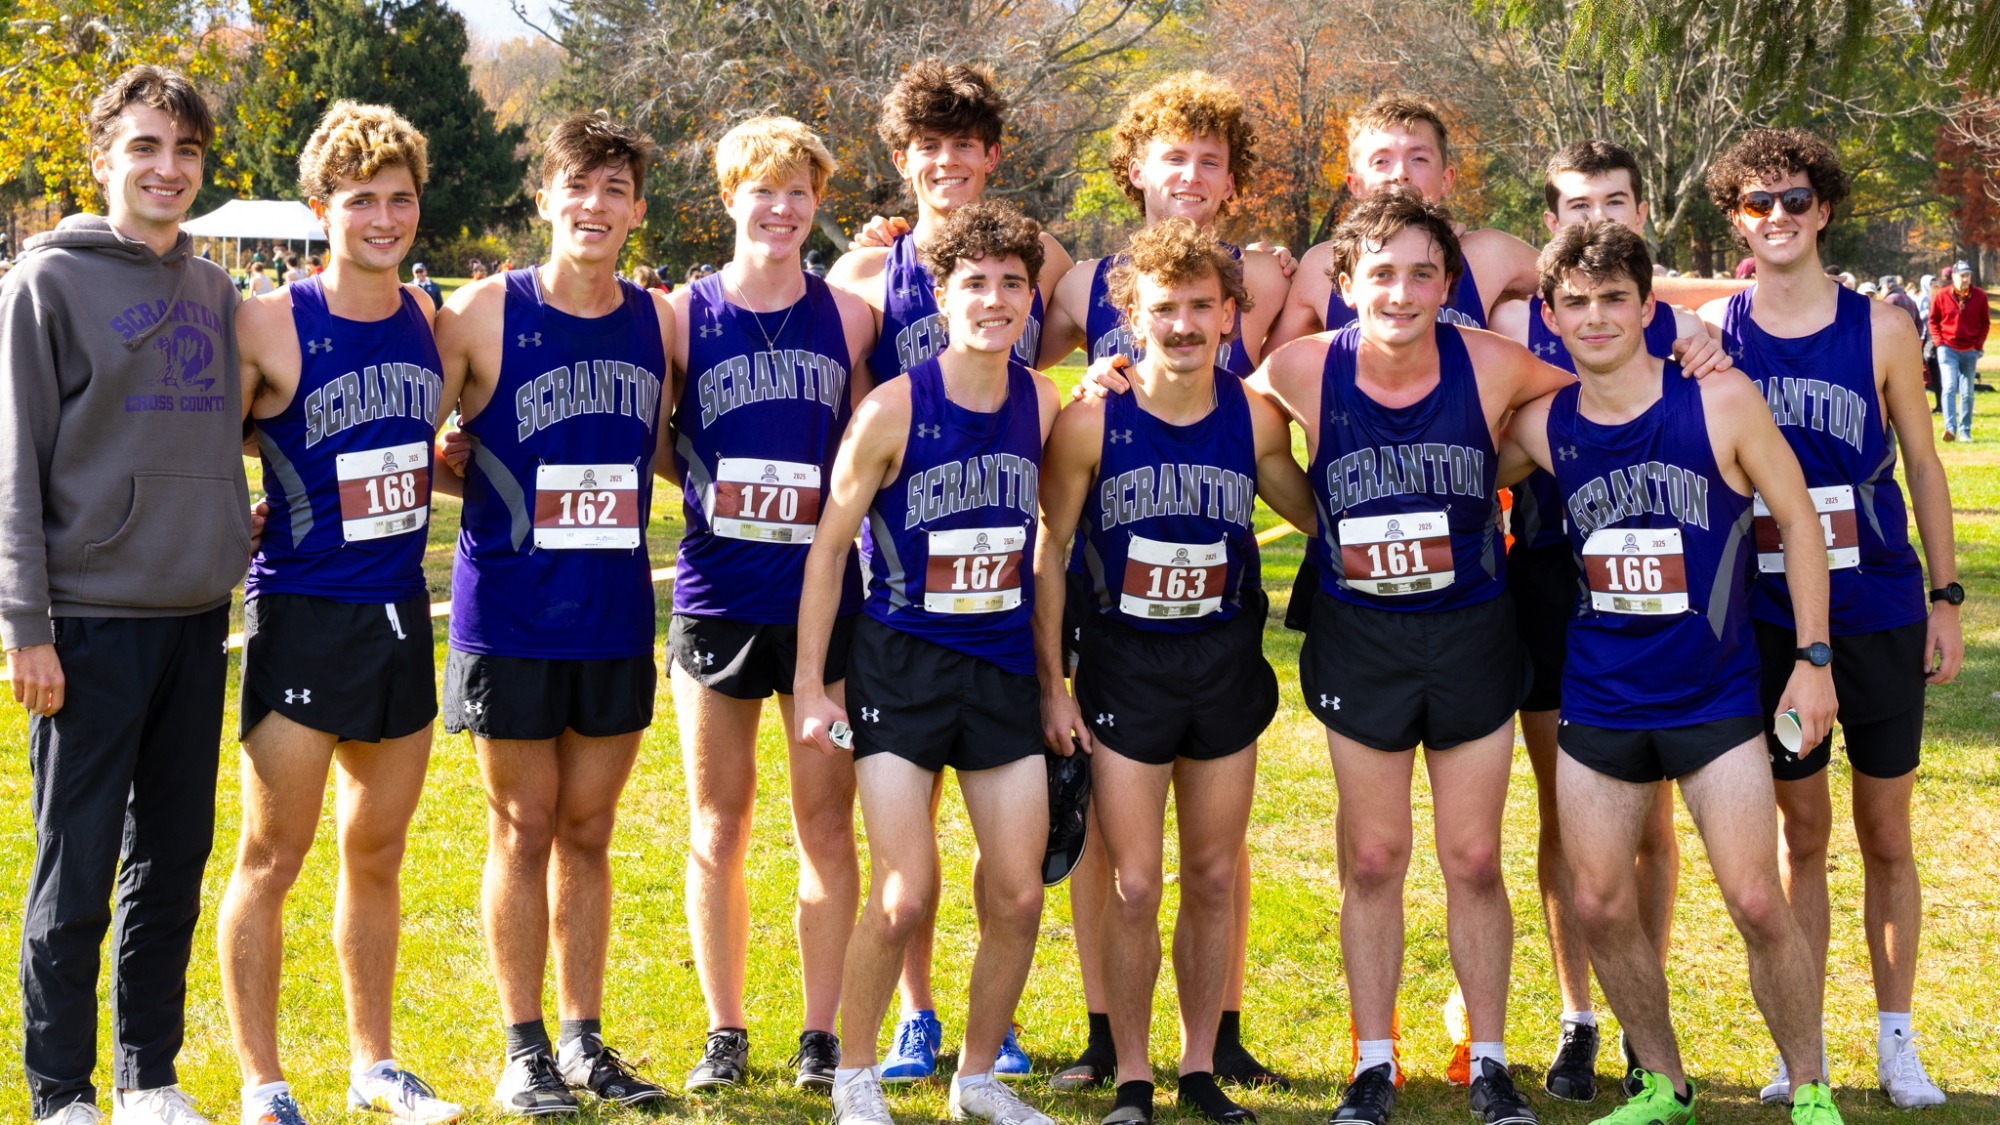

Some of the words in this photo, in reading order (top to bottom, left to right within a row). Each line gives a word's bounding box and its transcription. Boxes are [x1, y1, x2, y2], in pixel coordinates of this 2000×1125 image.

[895, 312, 1041, 374] SCRON
[126, 394, 174, 412] CROSS
[304, 362, 443, 450] SCRANTON
[515, 360, 661, 443] SCRANTON
[697, 349, 847, 430] SCRANTON
[1753, 376, 1867, 454] ANTON
[365, 472, 416, 515] 168
[904, 453, 1040, 530] SCRANTON
[1101, 463, 1254, 532] SCRANTON
[1326, 443, 1485, 516] SCRANTON
[1567, 461, 1710, 541] SCRANTON
[558, 491, 618, 526] 162
[739, 485, 799, 521] 170
[1418, 523, 1433, 531] 2025
[1652, 540, 1666, 548] 2025
[951, 554, 1009, 591] 167
[1367, 540, 1429, 578] 161
[1605, 556, 1663, 592] 166
[1146, 567, 1208, 600] 163
